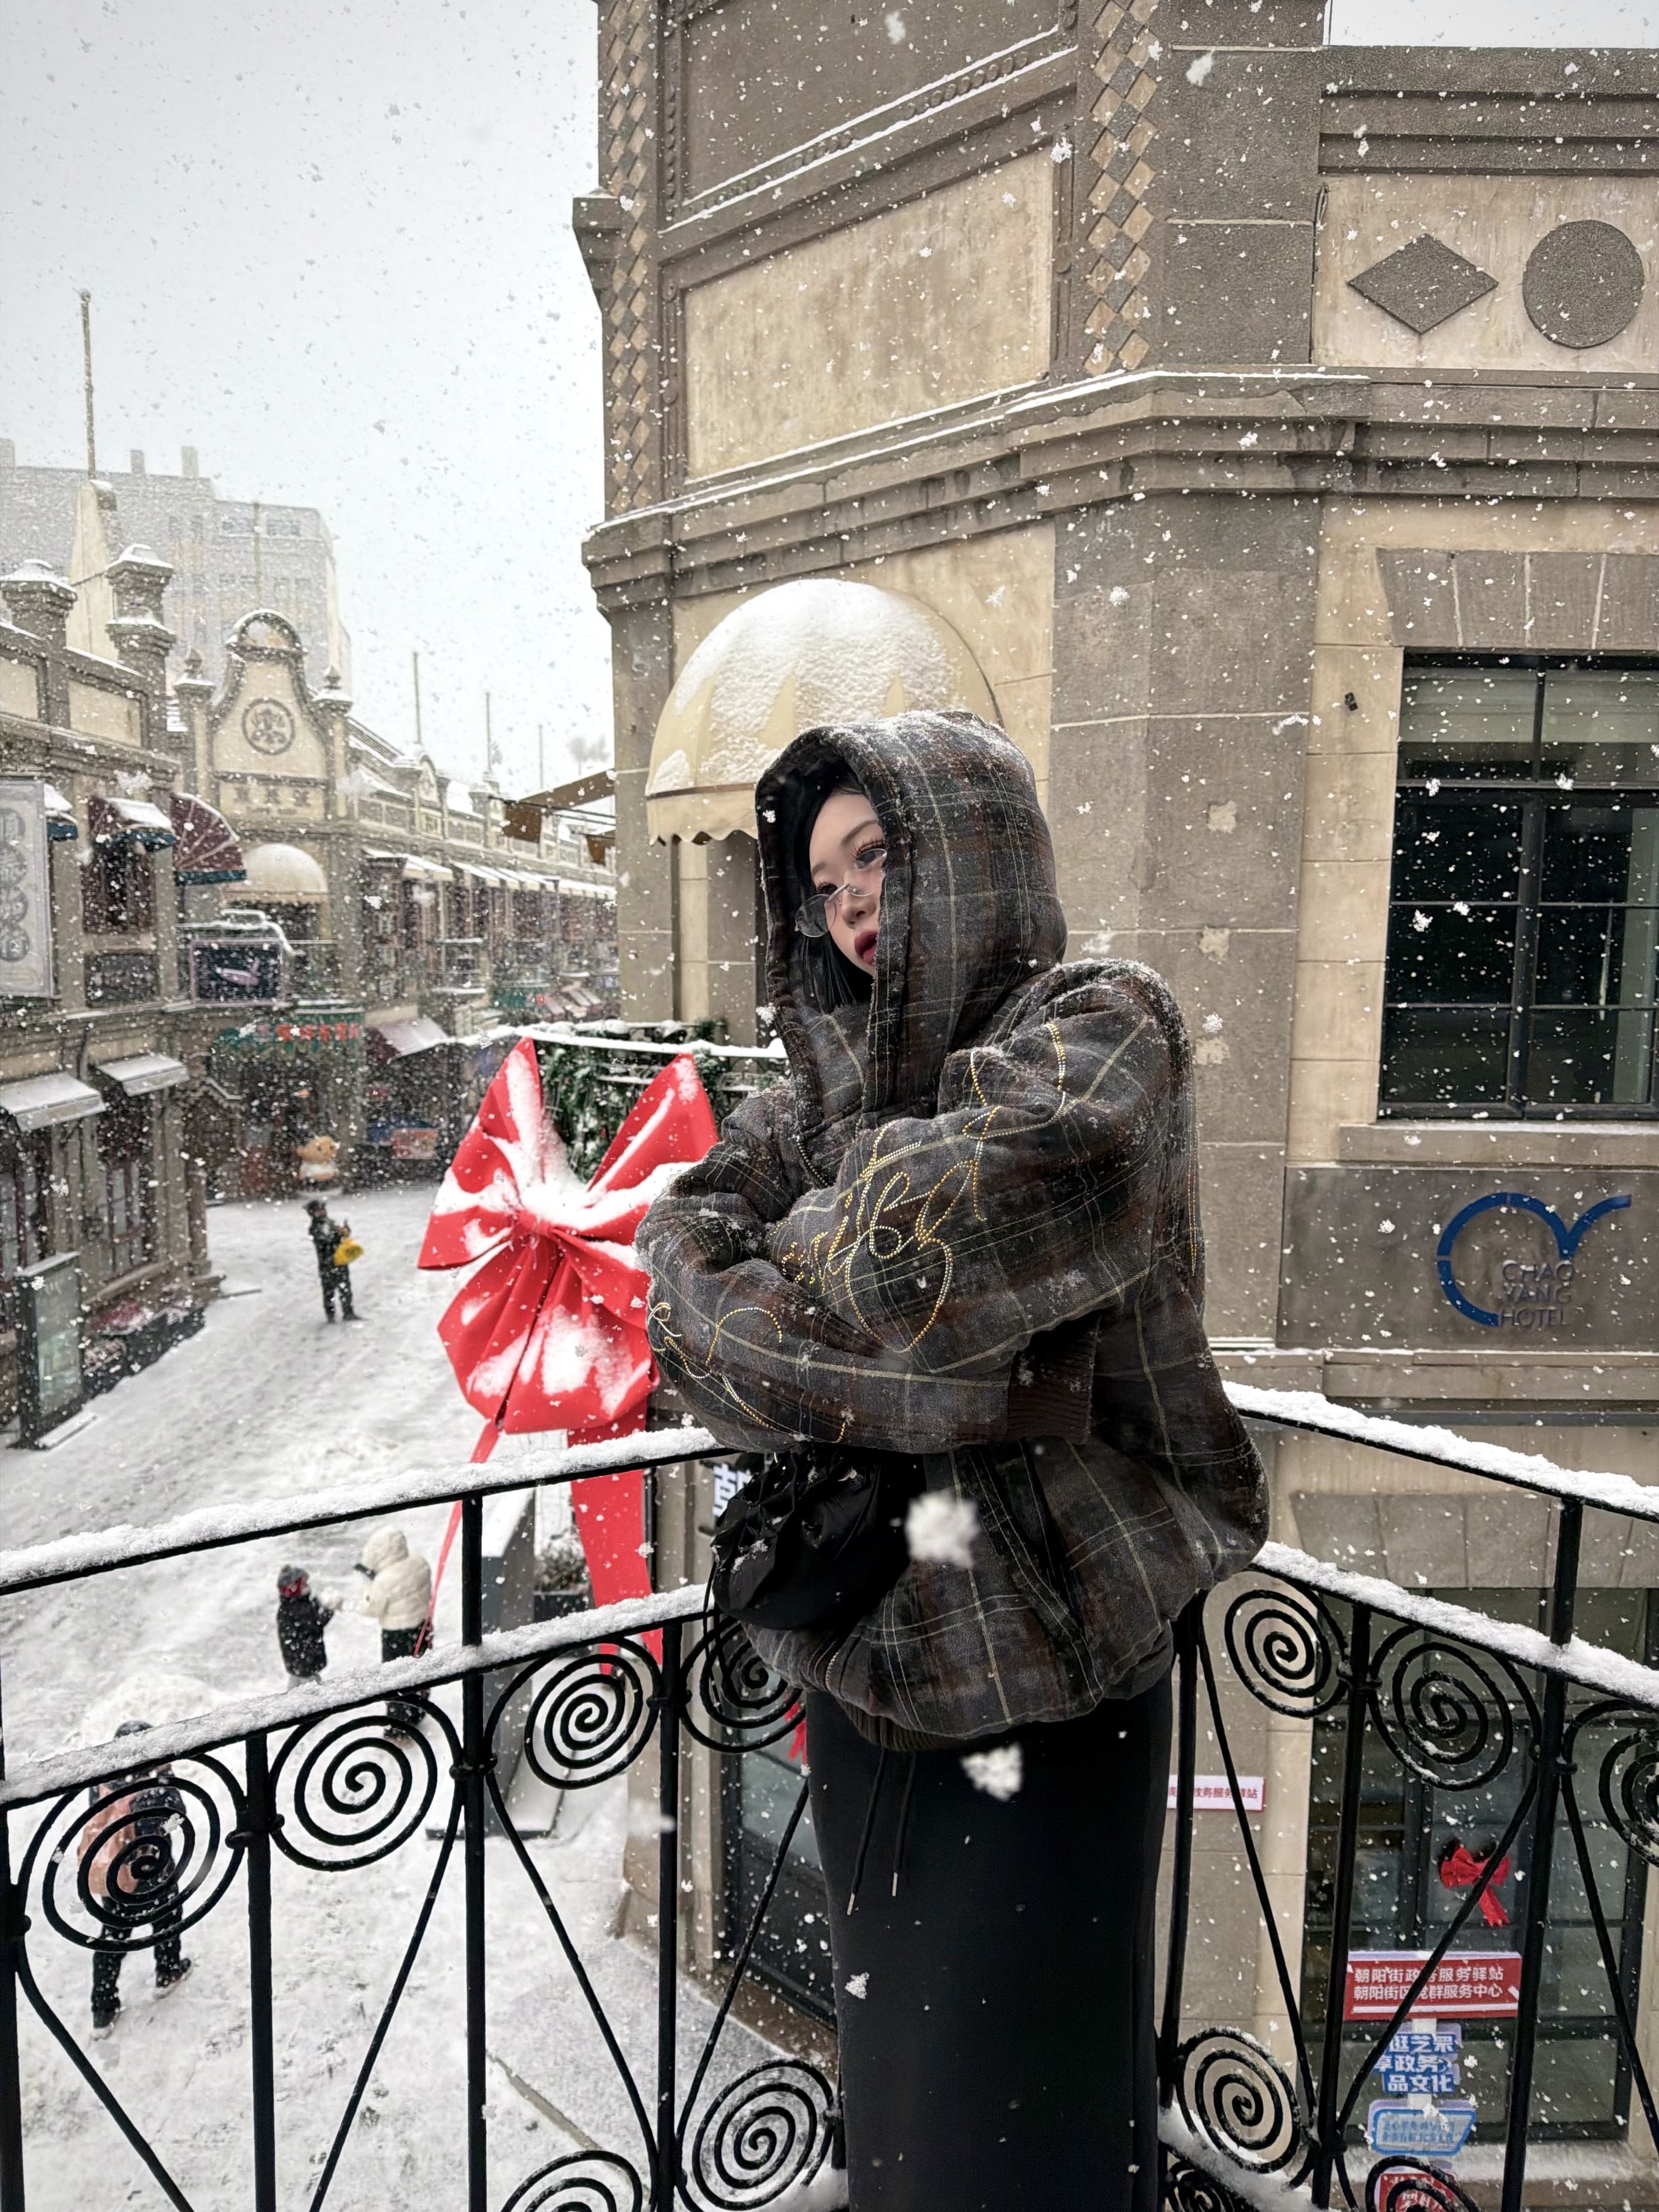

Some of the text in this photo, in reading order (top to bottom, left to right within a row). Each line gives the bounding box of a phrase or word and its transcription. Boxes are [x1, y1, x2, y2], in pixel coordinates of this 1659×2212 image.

[1502, 1260, 1575, 1282] CHAO
[1503, 1283, 1572, 1304] YANG
[1500, 1308, 1570, 1327] HOTEL
[1387, 2074, 1453, 2092] 品文化
